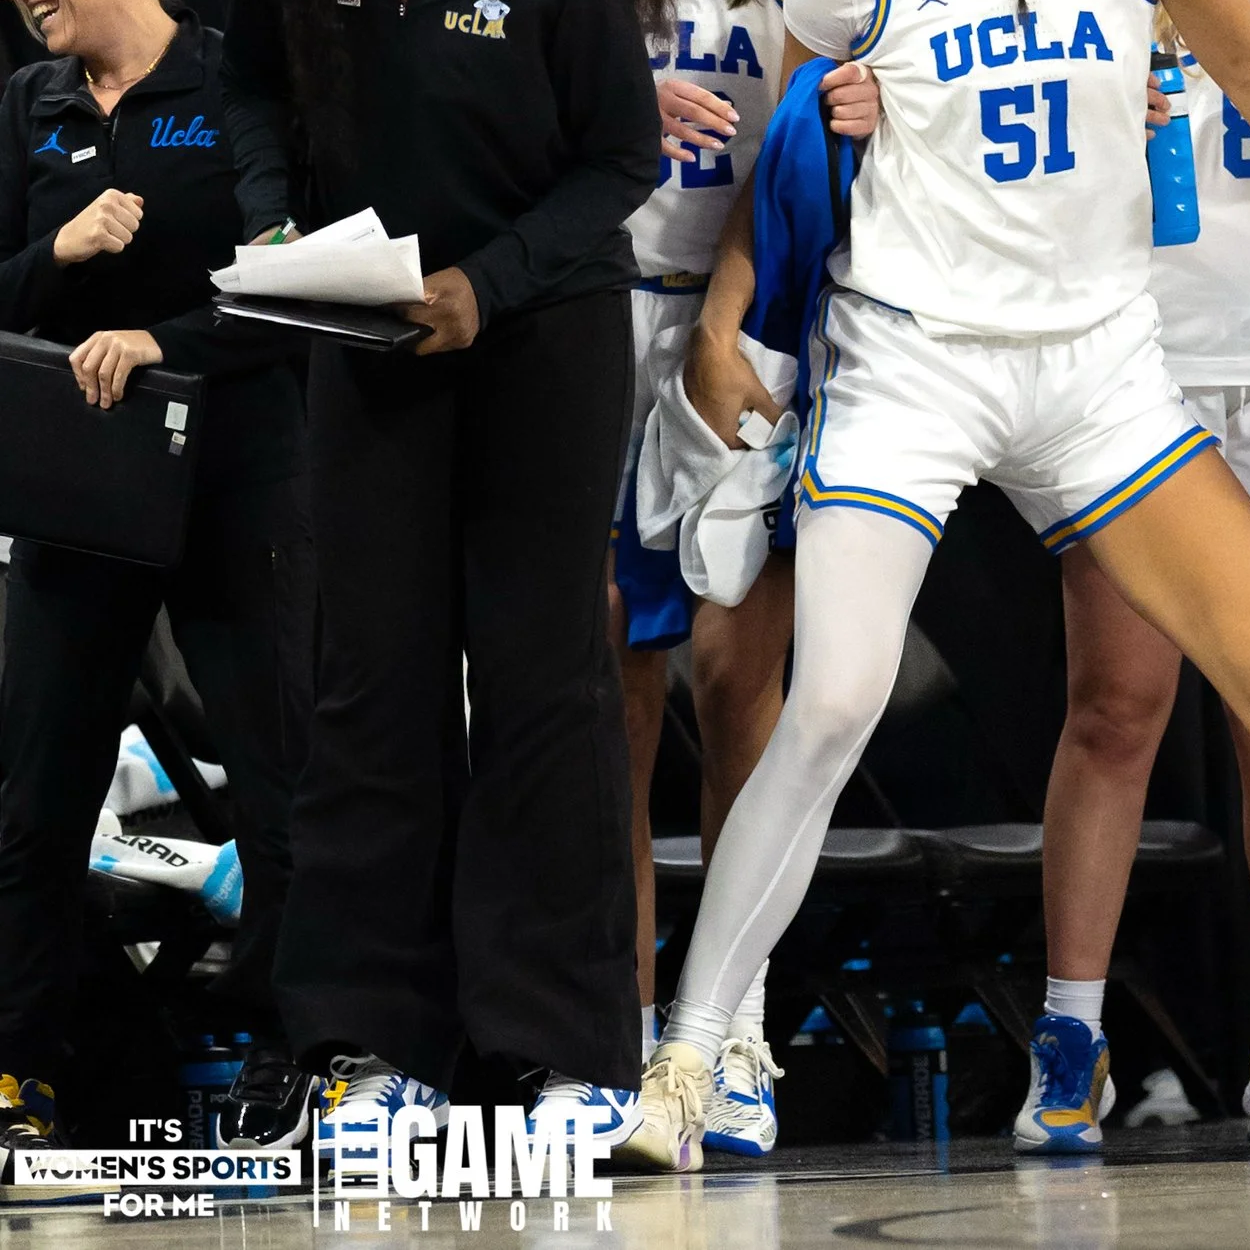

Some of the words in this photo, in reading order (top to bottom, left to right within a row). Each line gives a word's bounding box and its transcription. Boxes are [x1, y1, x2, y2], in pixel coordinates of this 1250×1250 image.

[929, 10, 1115, 83] UCLA
[150, 115, 217, 148] Ucla
[979, 78, 1076, 183] 51
